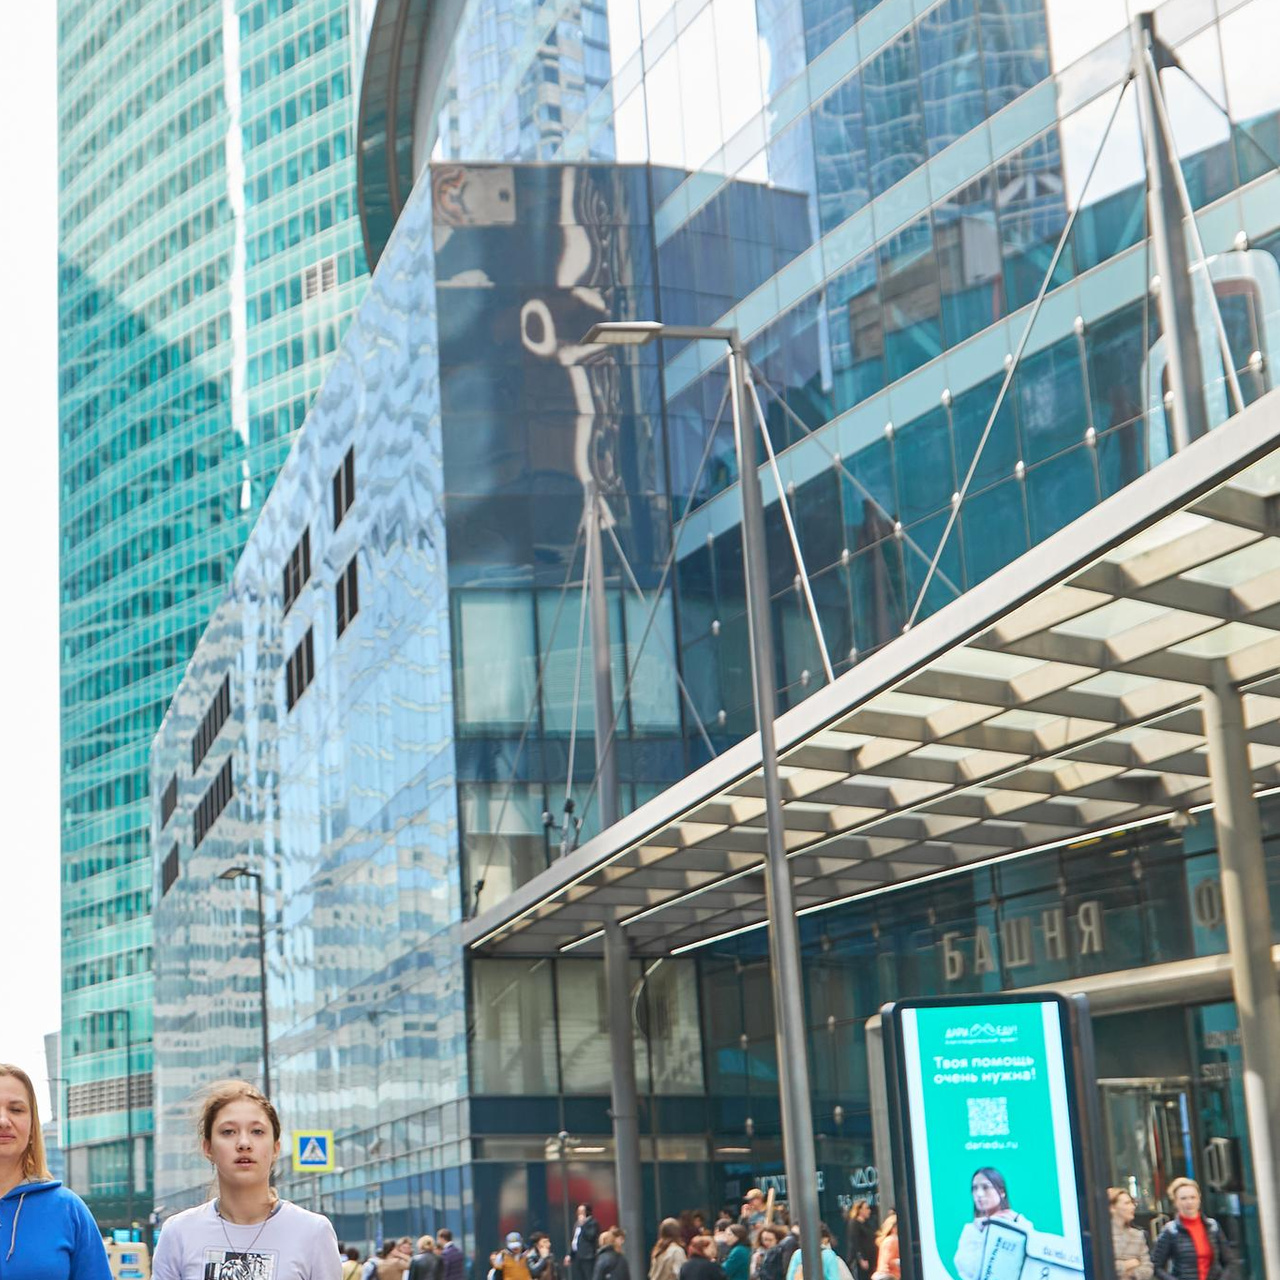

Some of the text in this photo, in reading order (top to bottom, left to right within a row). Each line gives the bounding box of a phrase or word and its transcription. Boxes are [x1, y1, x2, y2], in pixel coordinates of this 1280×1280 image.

[942, 901, 1104, 980] БАШНЯ
[933, 1056, 1035, 1069] Твоя помощь
[933, 1067, 1036, 1085] очень нужна!
